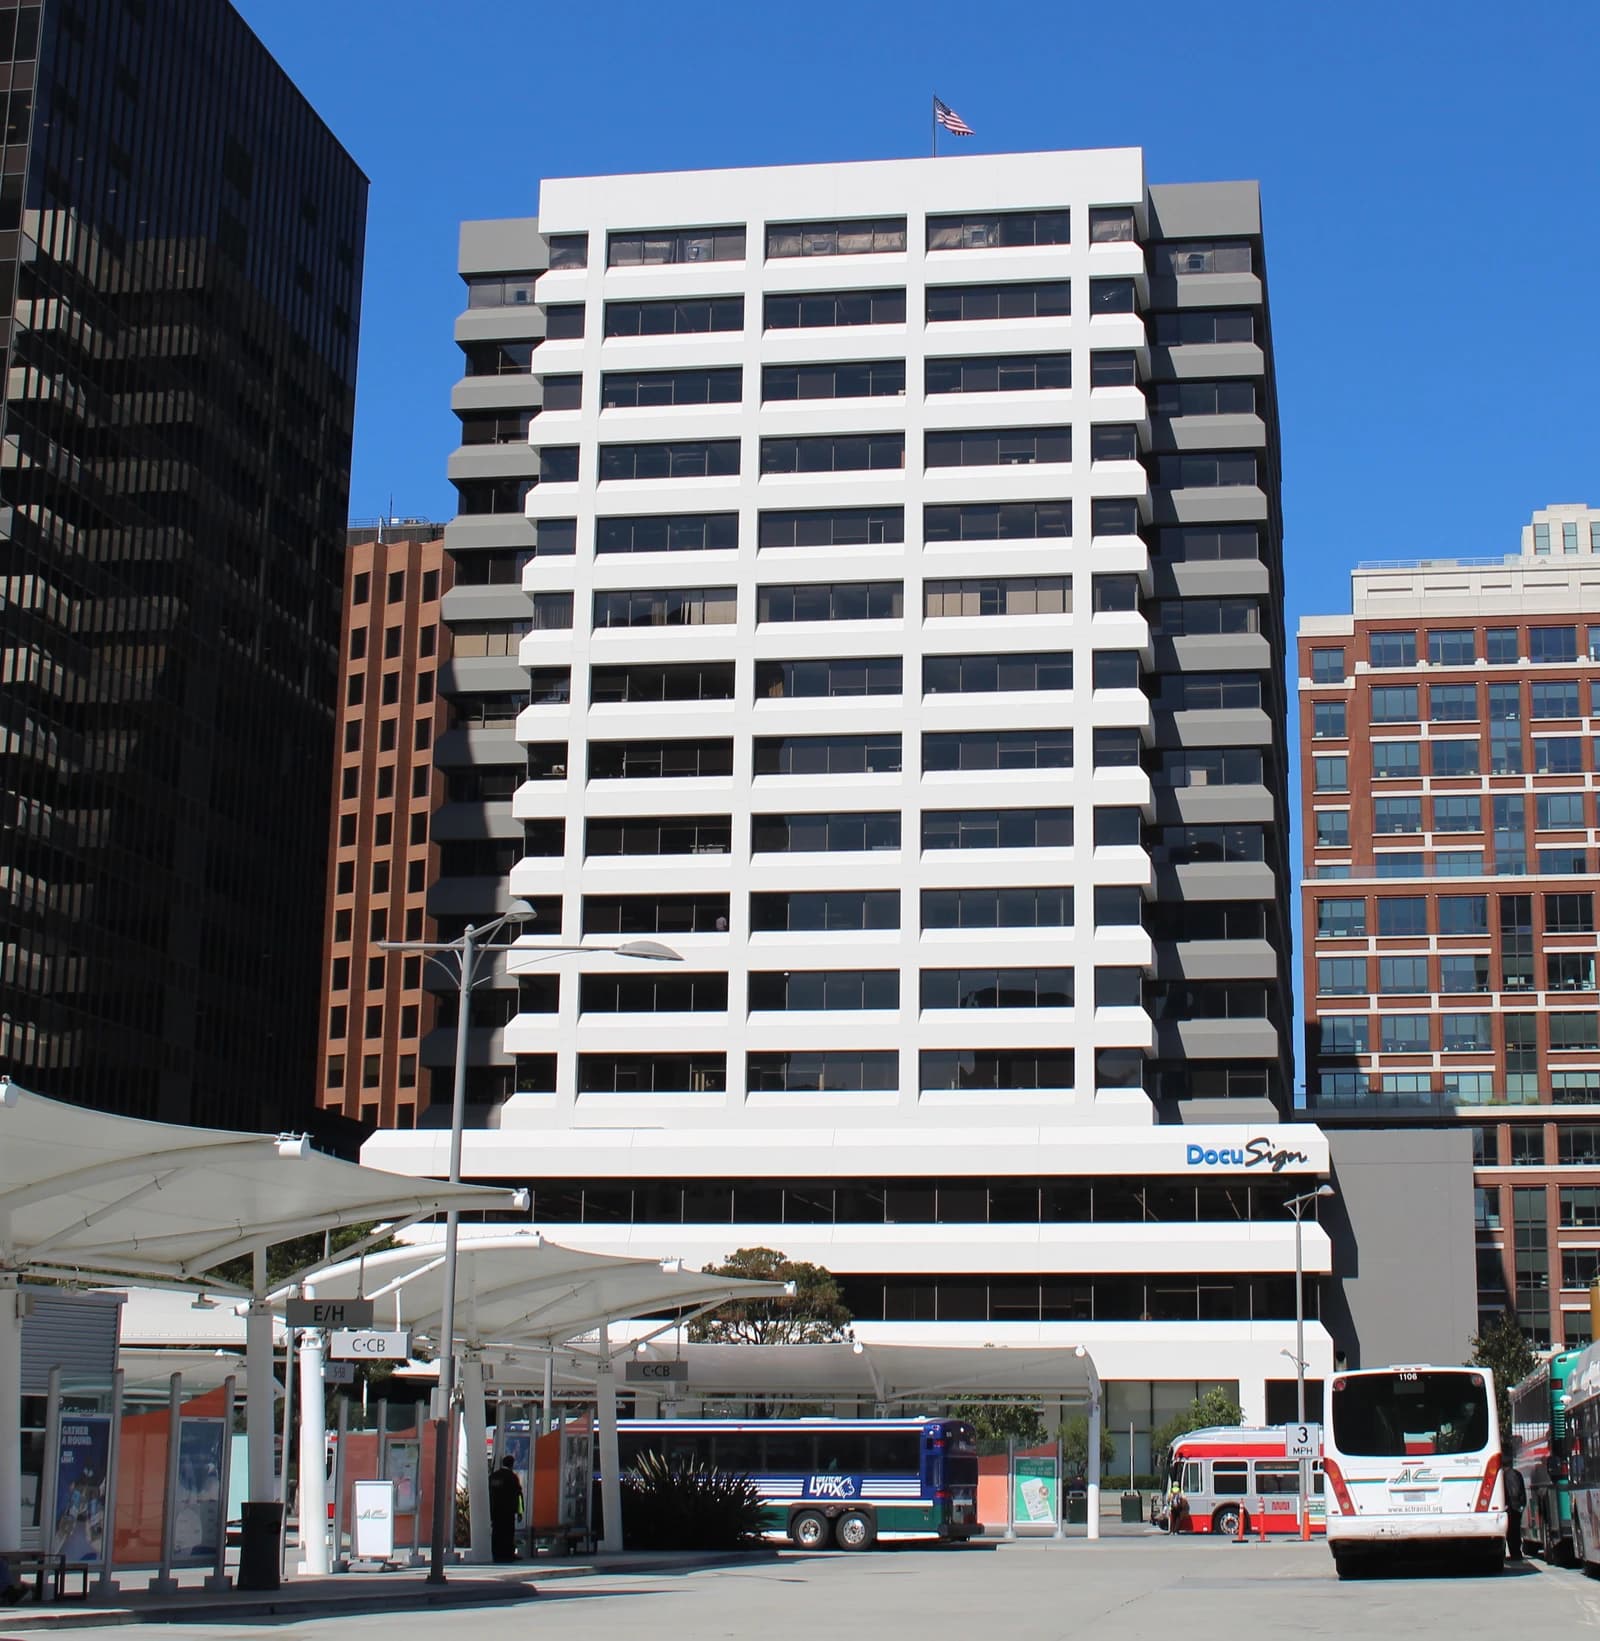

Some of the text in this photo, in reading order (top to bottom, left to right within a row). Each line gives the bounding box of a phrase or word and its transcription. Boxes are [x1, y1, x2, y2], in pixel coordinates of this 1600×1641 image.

[1186, 1137, 1307, 1172] DocuSign
[314, 1305, 345, 1321] E/H
[63, 1426, 89, 1435] GATHER
[1297, 1426, 1308, 1444] 3
[1293, 1447, 1313, 1455] MPH
